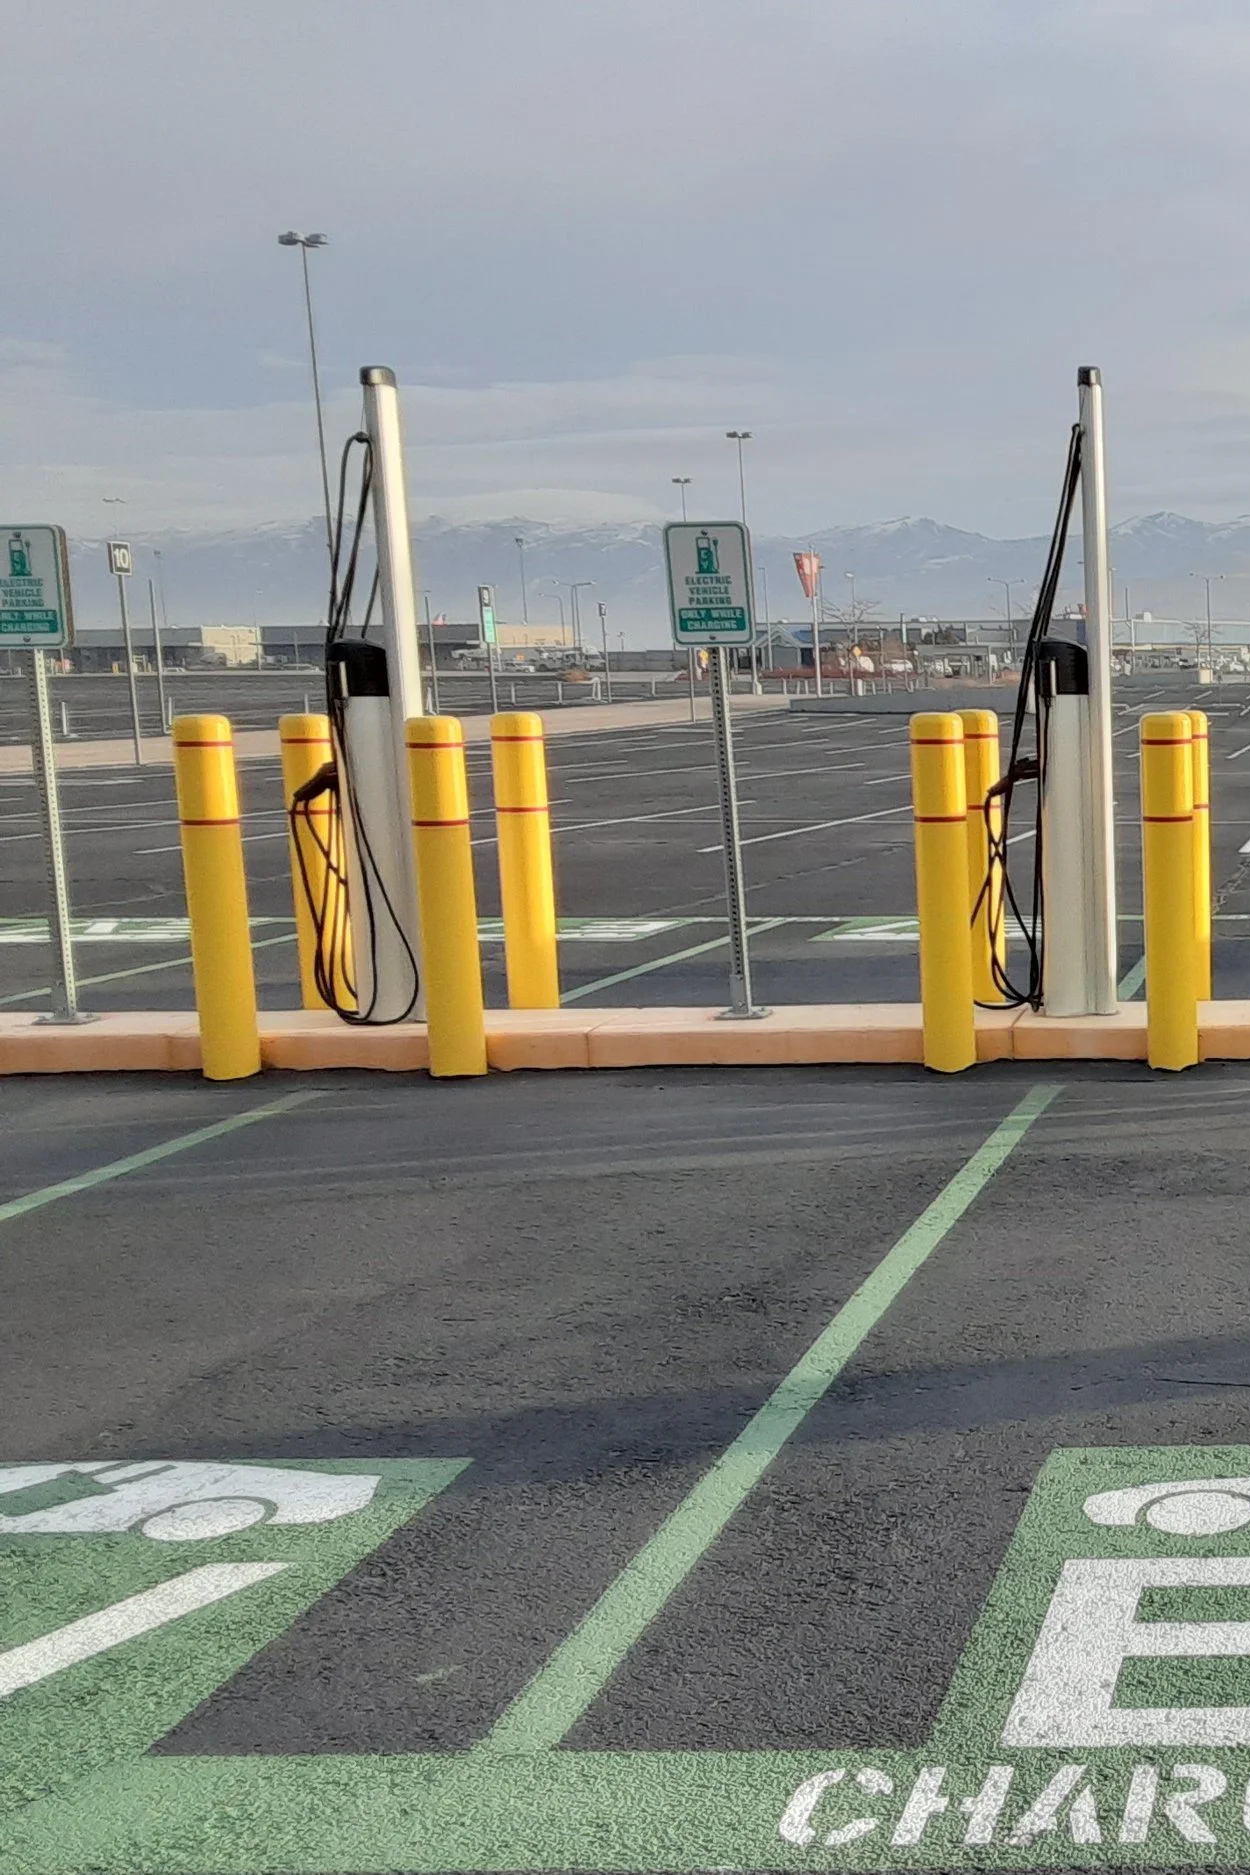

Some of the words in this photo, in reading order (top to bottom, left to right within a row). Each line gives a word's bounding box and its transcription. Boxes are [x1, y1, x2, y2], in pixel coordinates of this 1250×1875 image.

[113, 548, 129, 568] 10
[685, 576, 732, 585] ELECTRIC
[1, 588, 42, 597] VEHICLE
[689, 586, 730, 595] VEHICLE
[2, 598, 44, 607] PARKING
[688, 596, 732, 605] PARKING
[0, 612, 17, 621] NLY
[711, 608, 743, 618] WHILE
[687, 620, 737, 630] CHARGING
